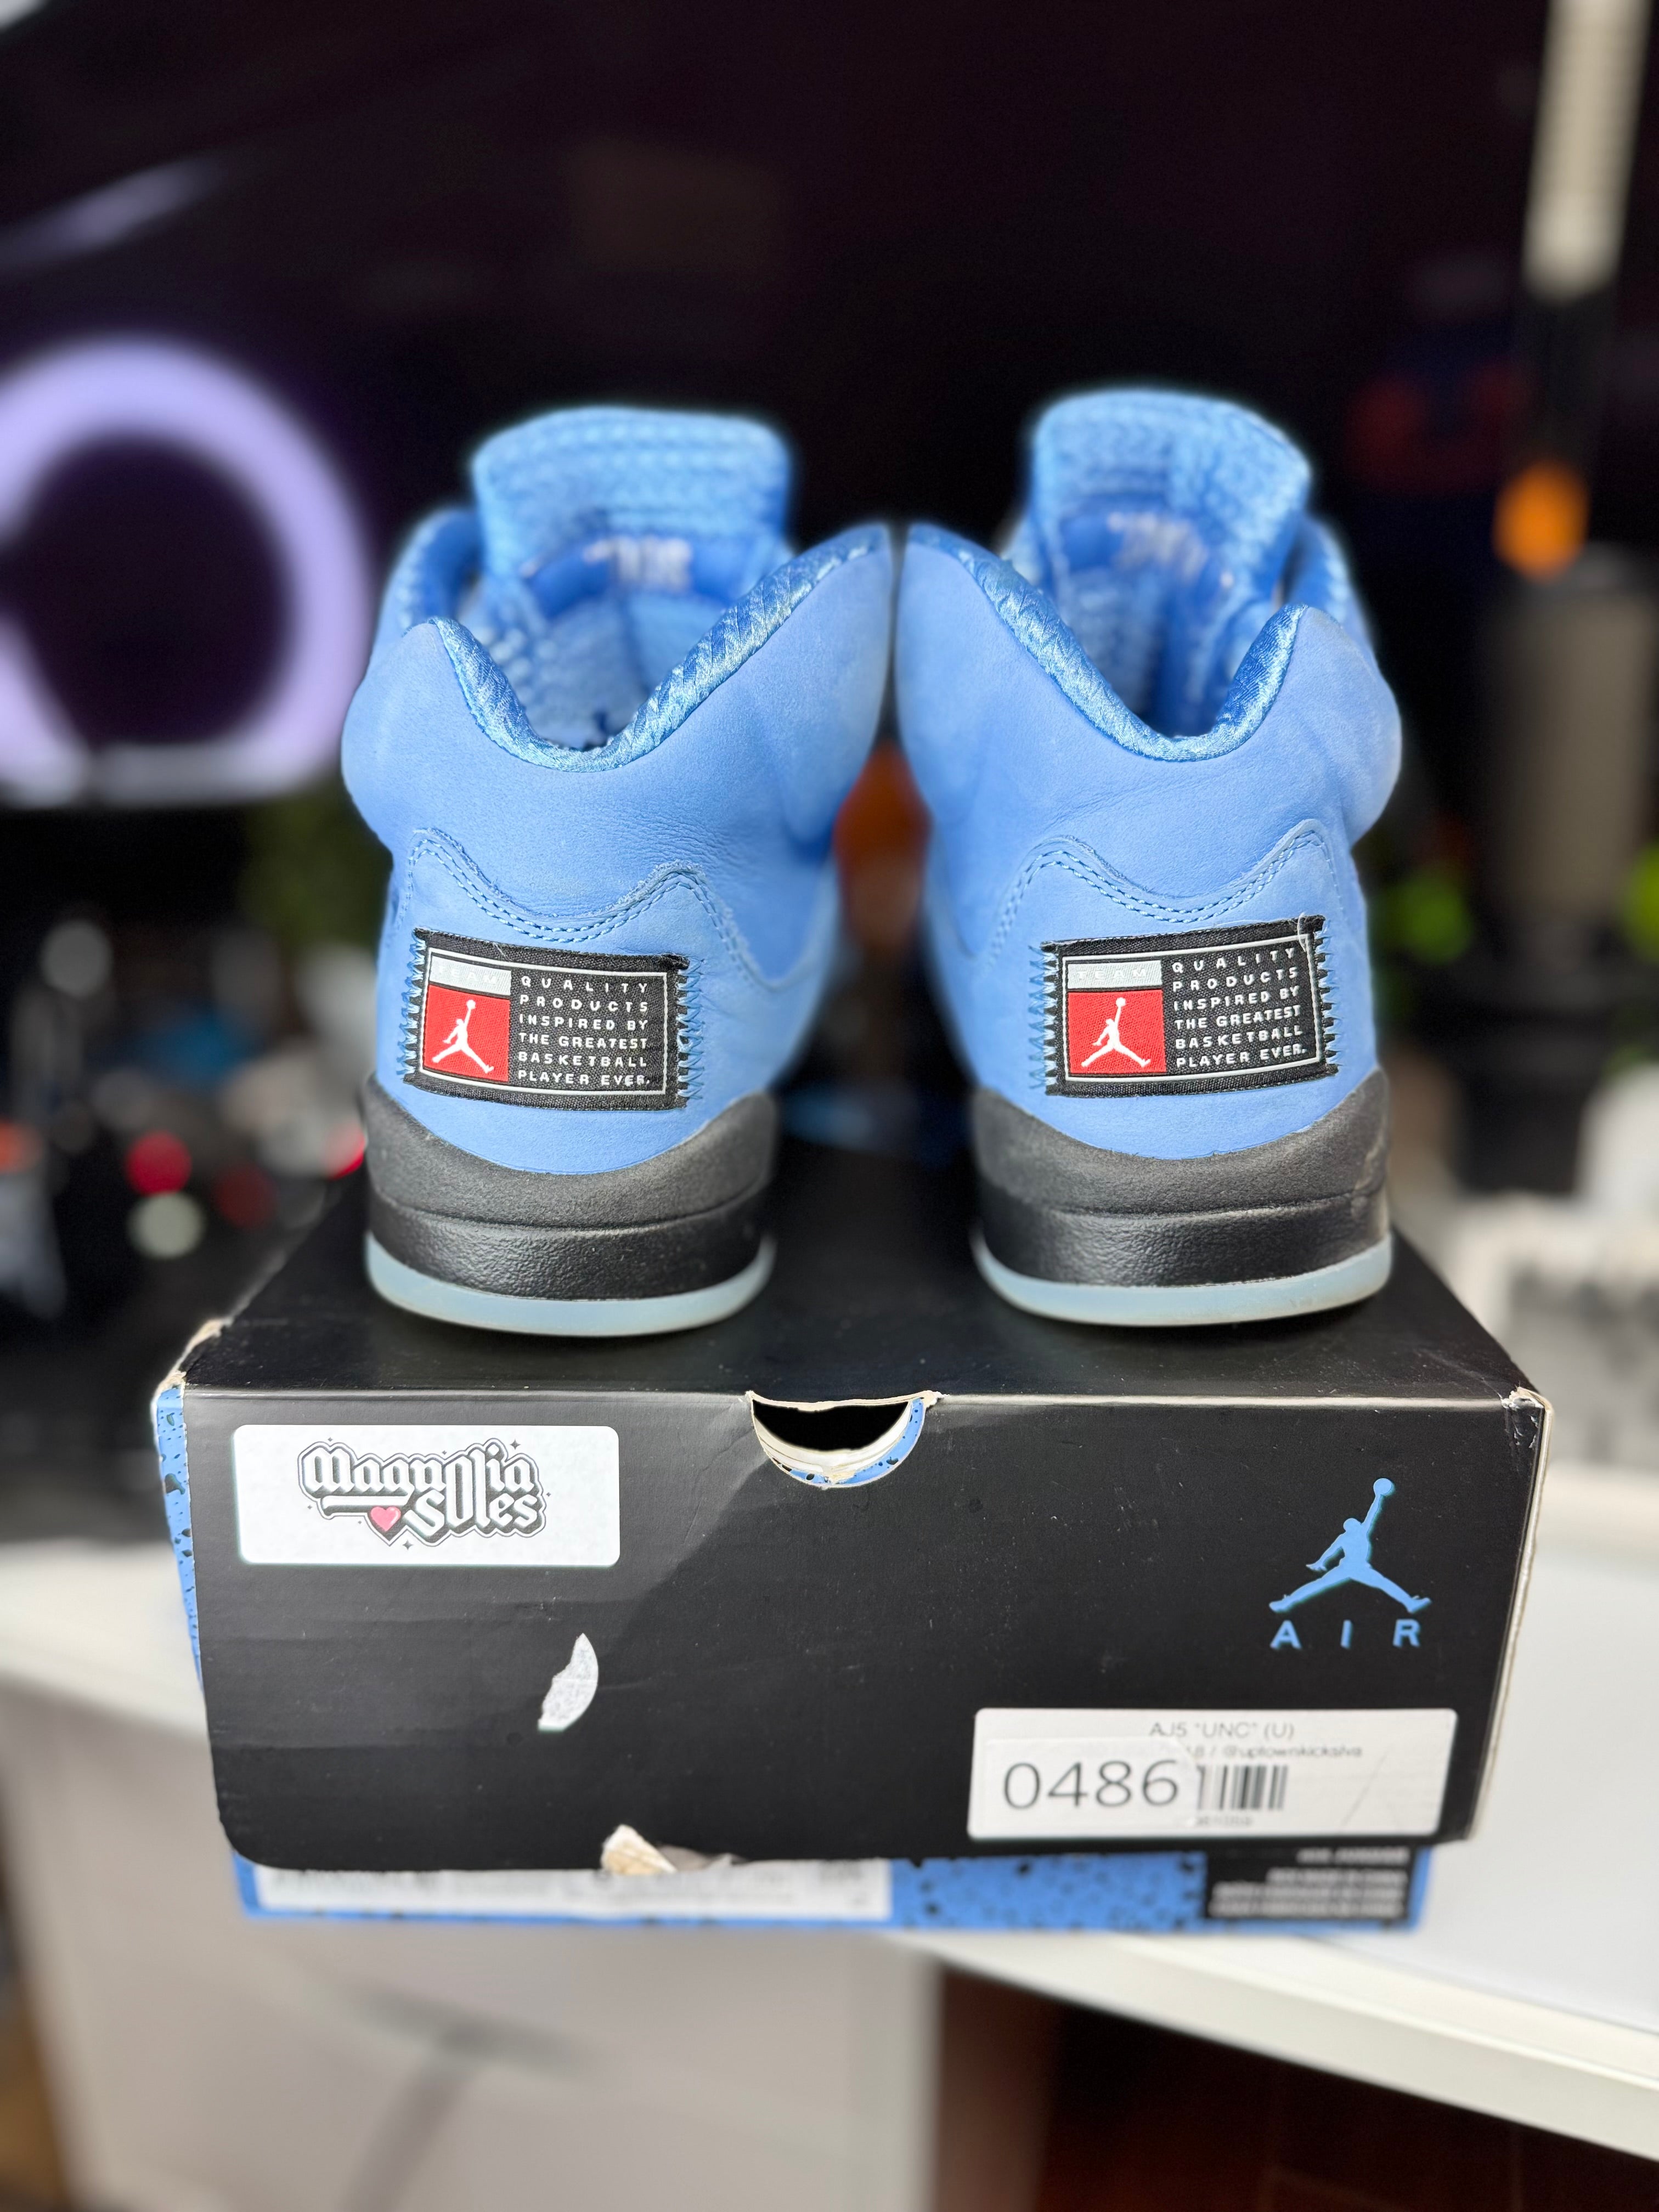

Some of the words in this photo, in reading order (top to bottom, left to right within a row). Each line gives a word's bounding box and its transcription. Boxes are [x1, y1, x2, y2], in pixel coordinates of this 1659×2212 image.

[1172, 947, 1295, 974] QUALITY
[438, 966, 497, 984] TEAM
[1076, 967, 1147, 980] TEAM
[1172, 967, 1298, 992] PRODUCTS
[521, 975, 647, 993] QUALITY
[520, 994, 648, 1012] PRODUCTS
[1173, 991, 1271, 1011] INSPIRED
[1279, 985, 1300, 1000] BY
[519, 1014, 615, 1030] INSPIRED
[627, 1019, 648, 1031] BY
[1174, 1017, 1207, 1030] THE
[1216, 1005, 1301, 1027] GREATEST
[518, 1032, 549, 1044] THE
[558, 1036, 647, 1049] GREATEST
[1175, 1025, 1303, 1049] BASKETBALL
[518, 1051, 647, 1067] BASKETBALL
[1176, 1051, 1250, 1068] PLAYER
[1260, 1043, 1307, 1060] EVER.
[518, 1069, 589, 1085] PLAYER
[601, 1073, 650, 1087] EVER.
[1270, 1619, 1422, 1649] AIR
[1149, 1722, 1188, 1738] AJ5
[1264, 1722, 1294, 1740] (U)
[1003, 1759, 1178, 1809] 0486
